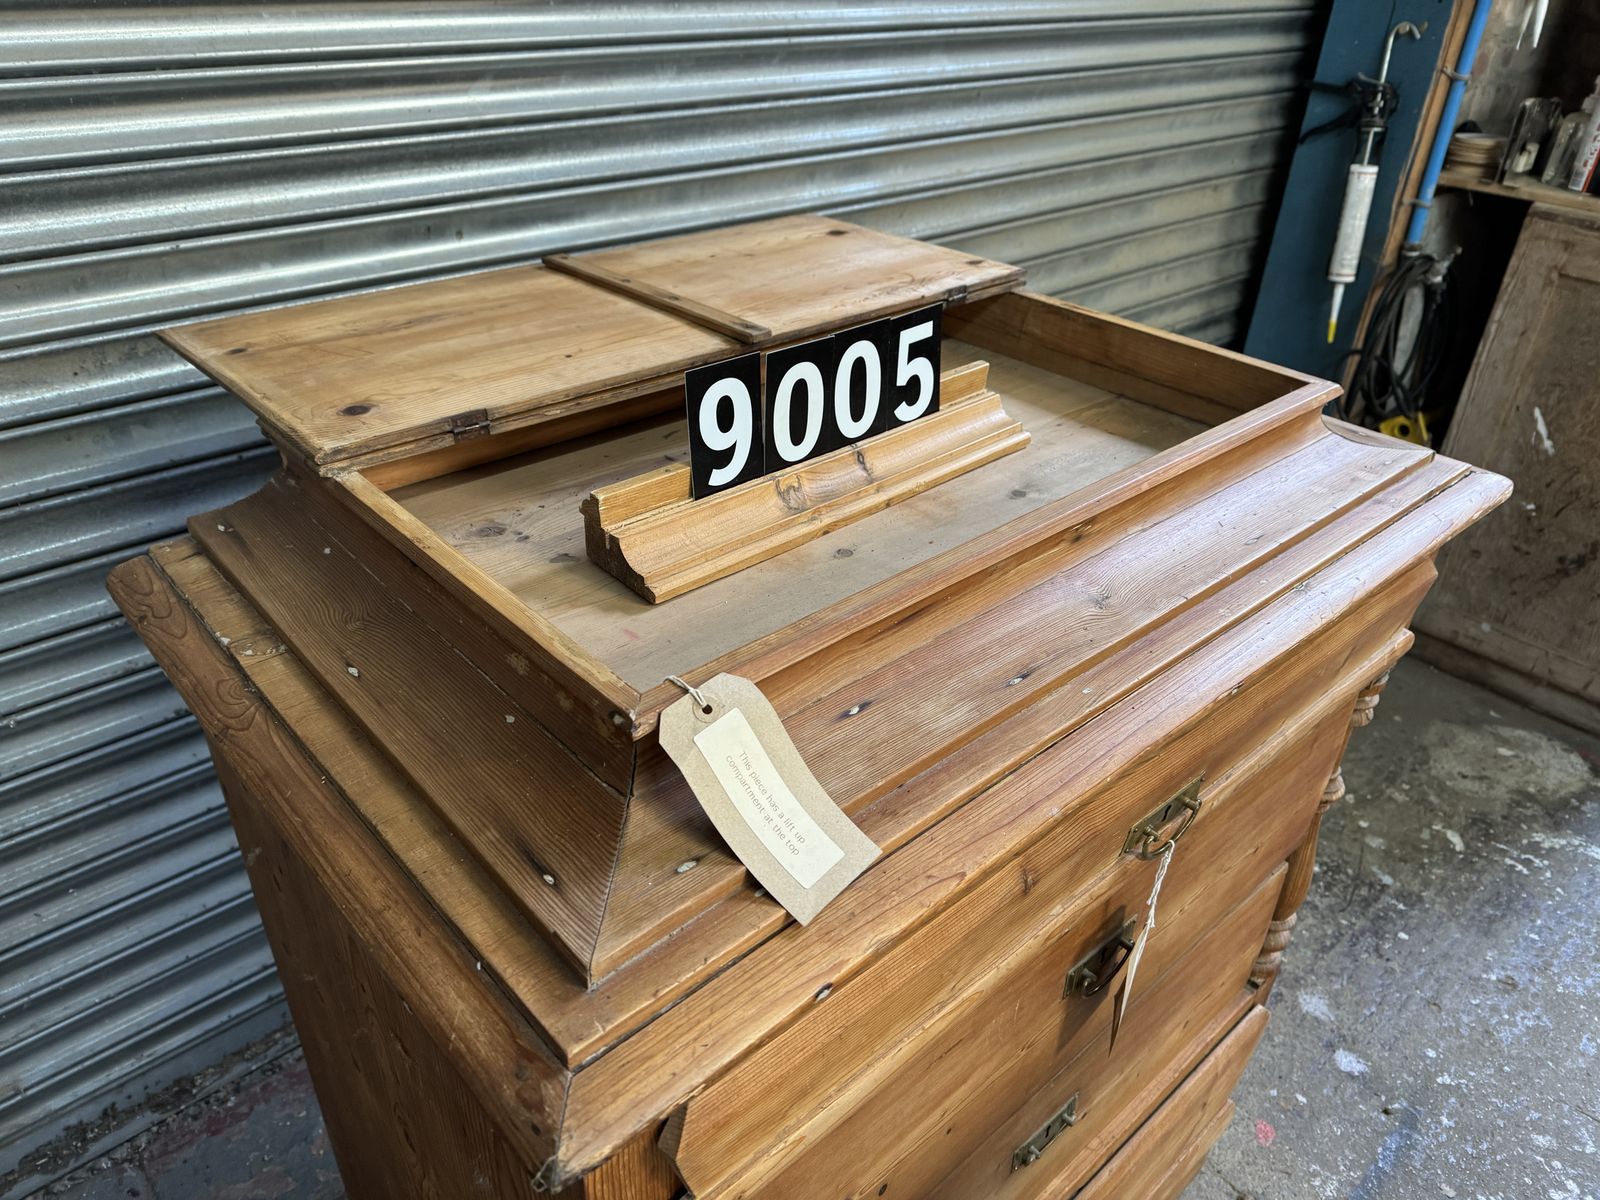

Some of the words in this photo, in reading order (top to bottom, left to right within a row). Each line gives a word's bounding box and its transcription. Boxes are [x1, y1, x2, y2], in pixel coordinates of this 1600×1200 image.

[699, 320, 935, 487] 9005
[726, 755, 765, 814] compartment
[764, 814, 774, 824] at
[772, 824, 786, 841] the
[785, 840, 800, 856] top
[739, 751, 753, 771] This
[748, 771, 768, 796] piece
[766, 794, 780, 812] has
[778, 812, 785, 820] a
[783, 818, 796, 832] lift
[794, 832, 806, 844] up
